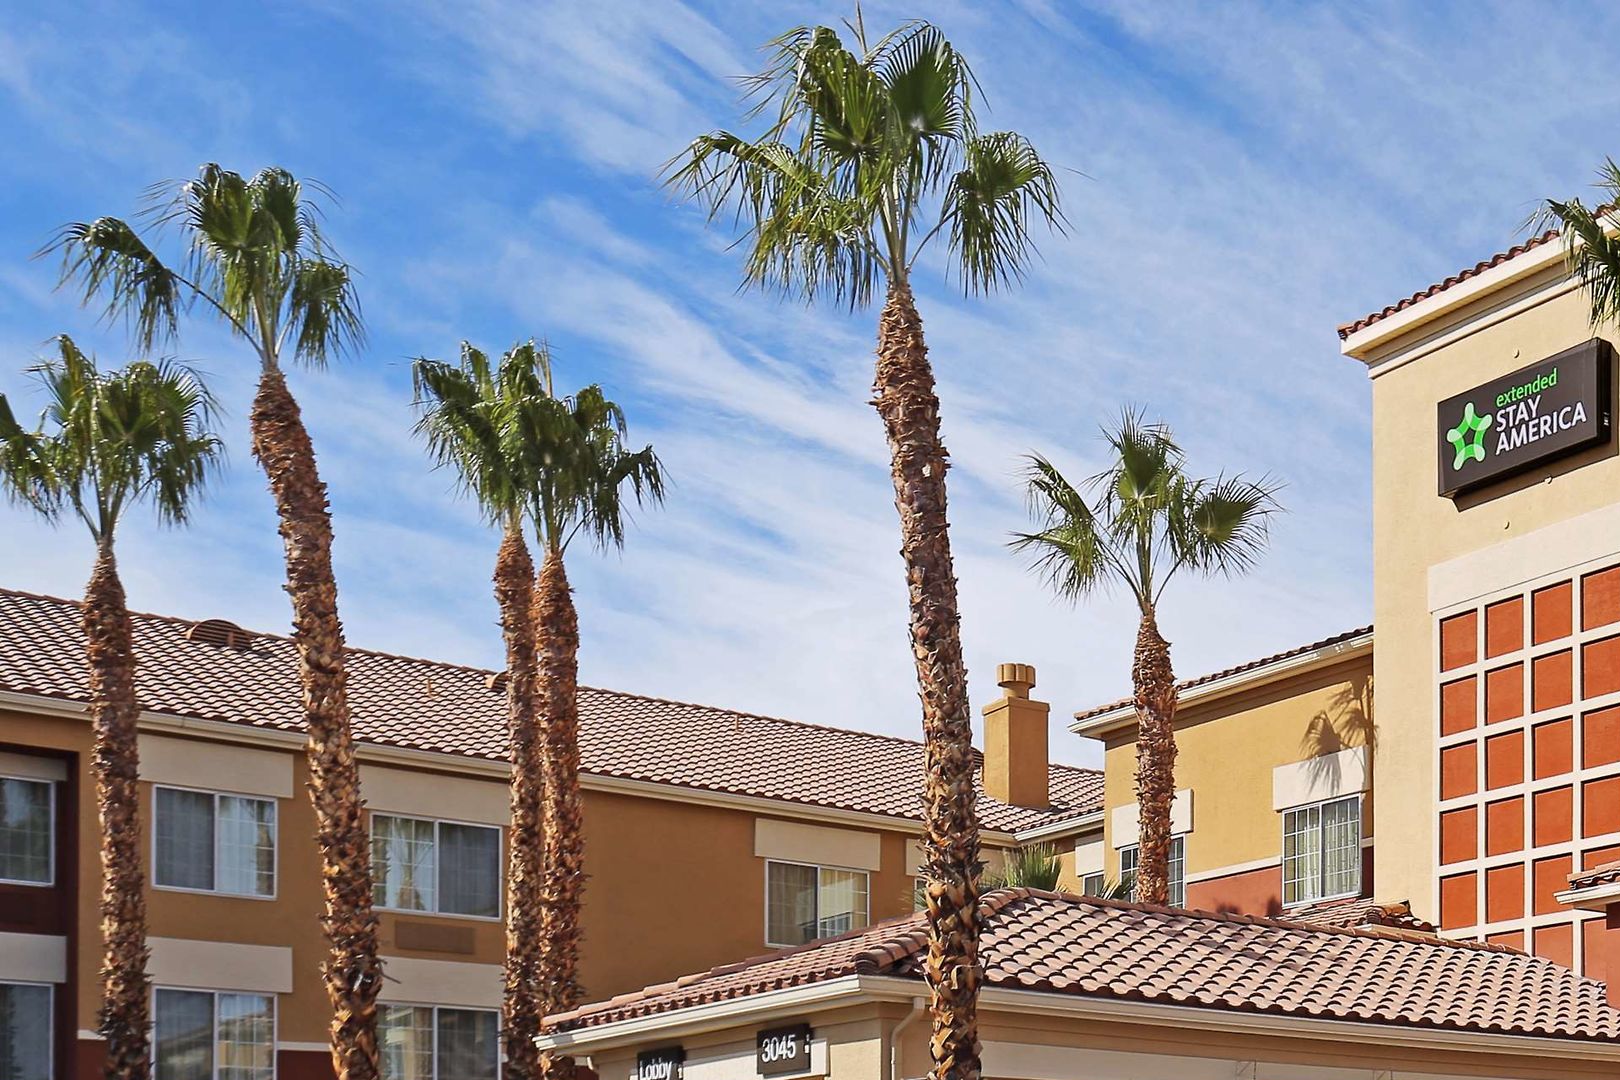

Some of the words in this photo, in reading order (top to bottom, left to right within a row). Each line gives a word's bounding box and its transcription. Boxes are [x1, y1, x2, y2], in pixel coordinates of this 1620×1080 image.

[1496, 368, 1558, 407] extended
[1495, 395, 1541, 432] STAY
[1495, 402, 1587, 455] AMERICA
[762, 1034, 796, 1062] 3045
